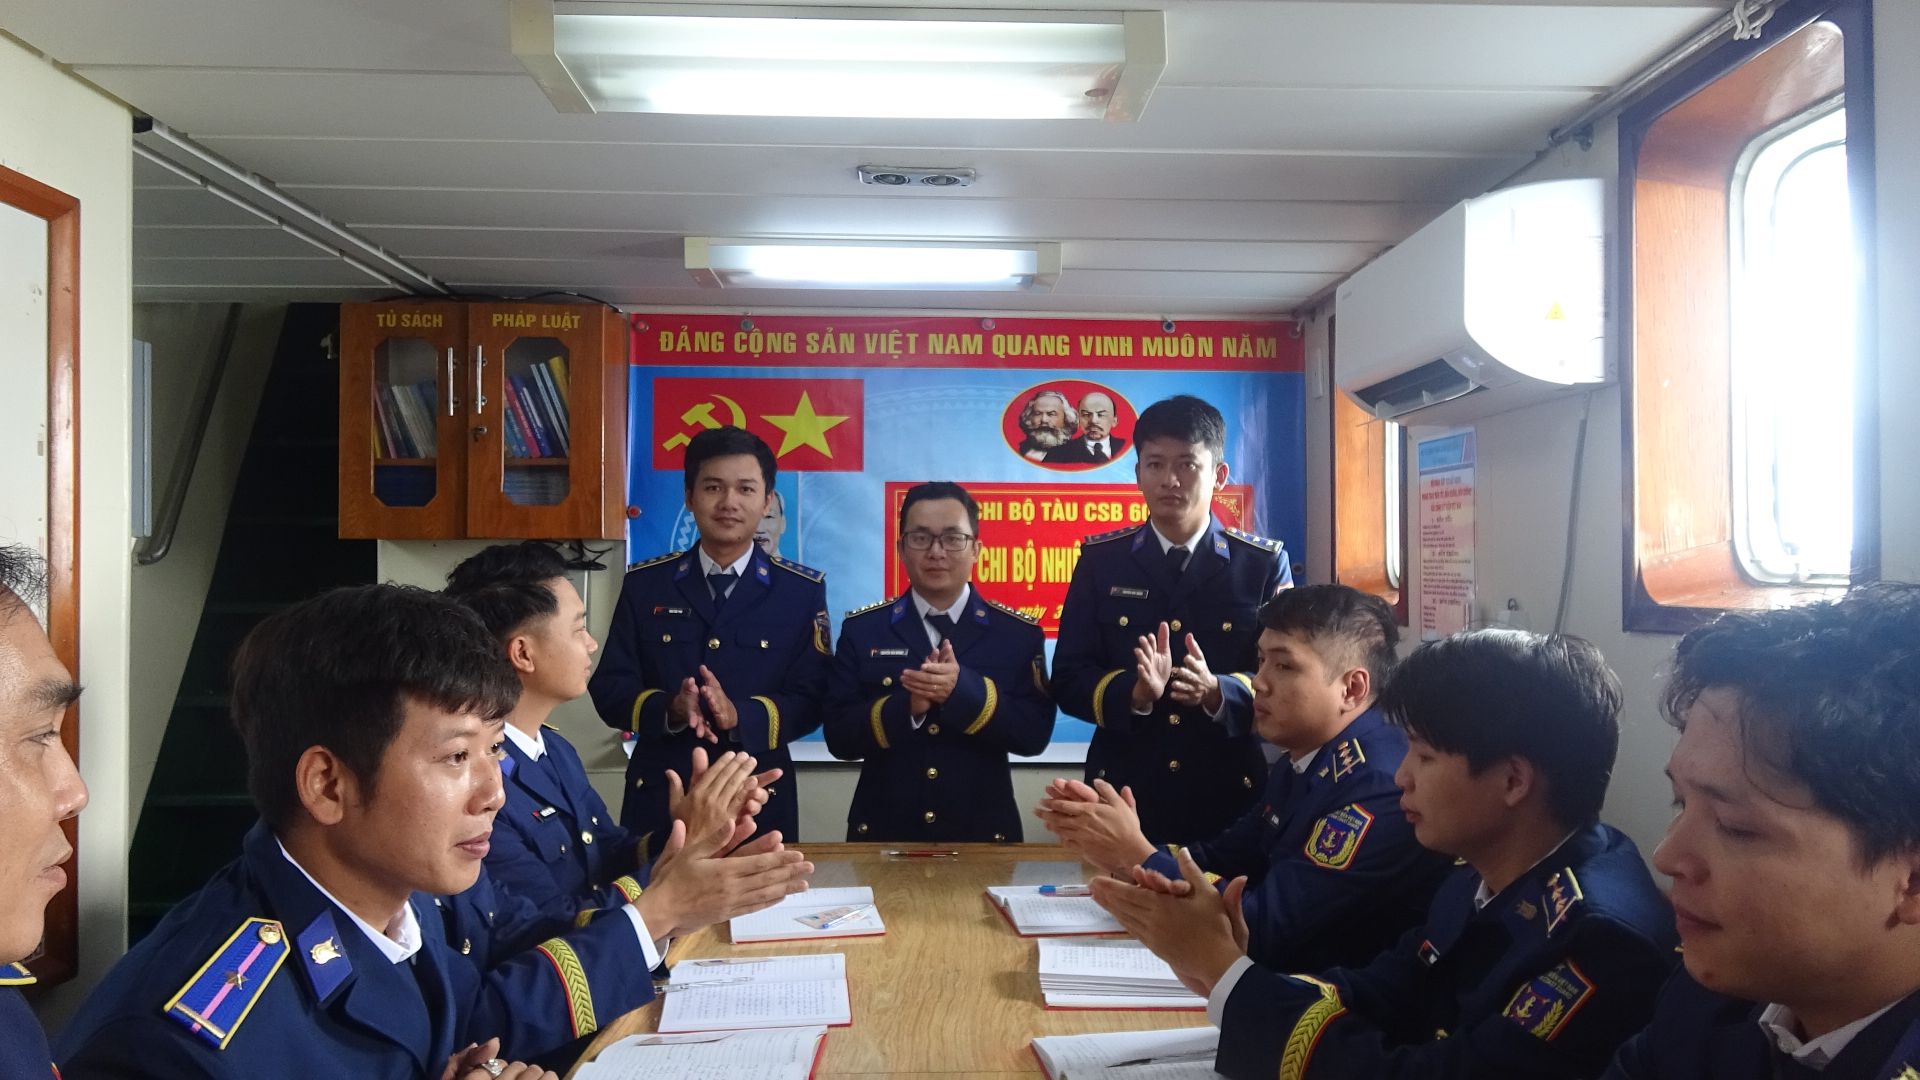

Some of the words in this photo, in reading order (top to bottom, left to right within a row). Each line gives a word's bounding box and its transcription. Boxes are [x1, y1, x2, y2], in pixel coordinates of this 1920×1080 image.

[375, 308, 397, 328] TỦ
[401, 309, 443, 328] SÁCH
[492, 310, 537, 328] PHÁP
[541, 312, 581, 332] LUẬT
[658, 326, 726, 353] ĐẢNG
[733, 328, 798, 358] CỘNG
[805, 327, 856, 354] SẢN
[864, 329, 920, 359] VIỆT
[928, 332, 983, 355] NAM
[991, 334, 1071, 359] QUANG
[1079, 335, 1134, 357] VINH
[1142, 333, 1214, 358] MUÔN
[1221, 333, 1278, 359] NĂM
[1008, 498, 1036, 525] BỘ
[1041, 499, 1079, 522] TÀU
[1084, 502, 1124, 522] CSB
[977, 546, 1008, 583] CHI
[1012, 539, 1037, 591] BỘ
